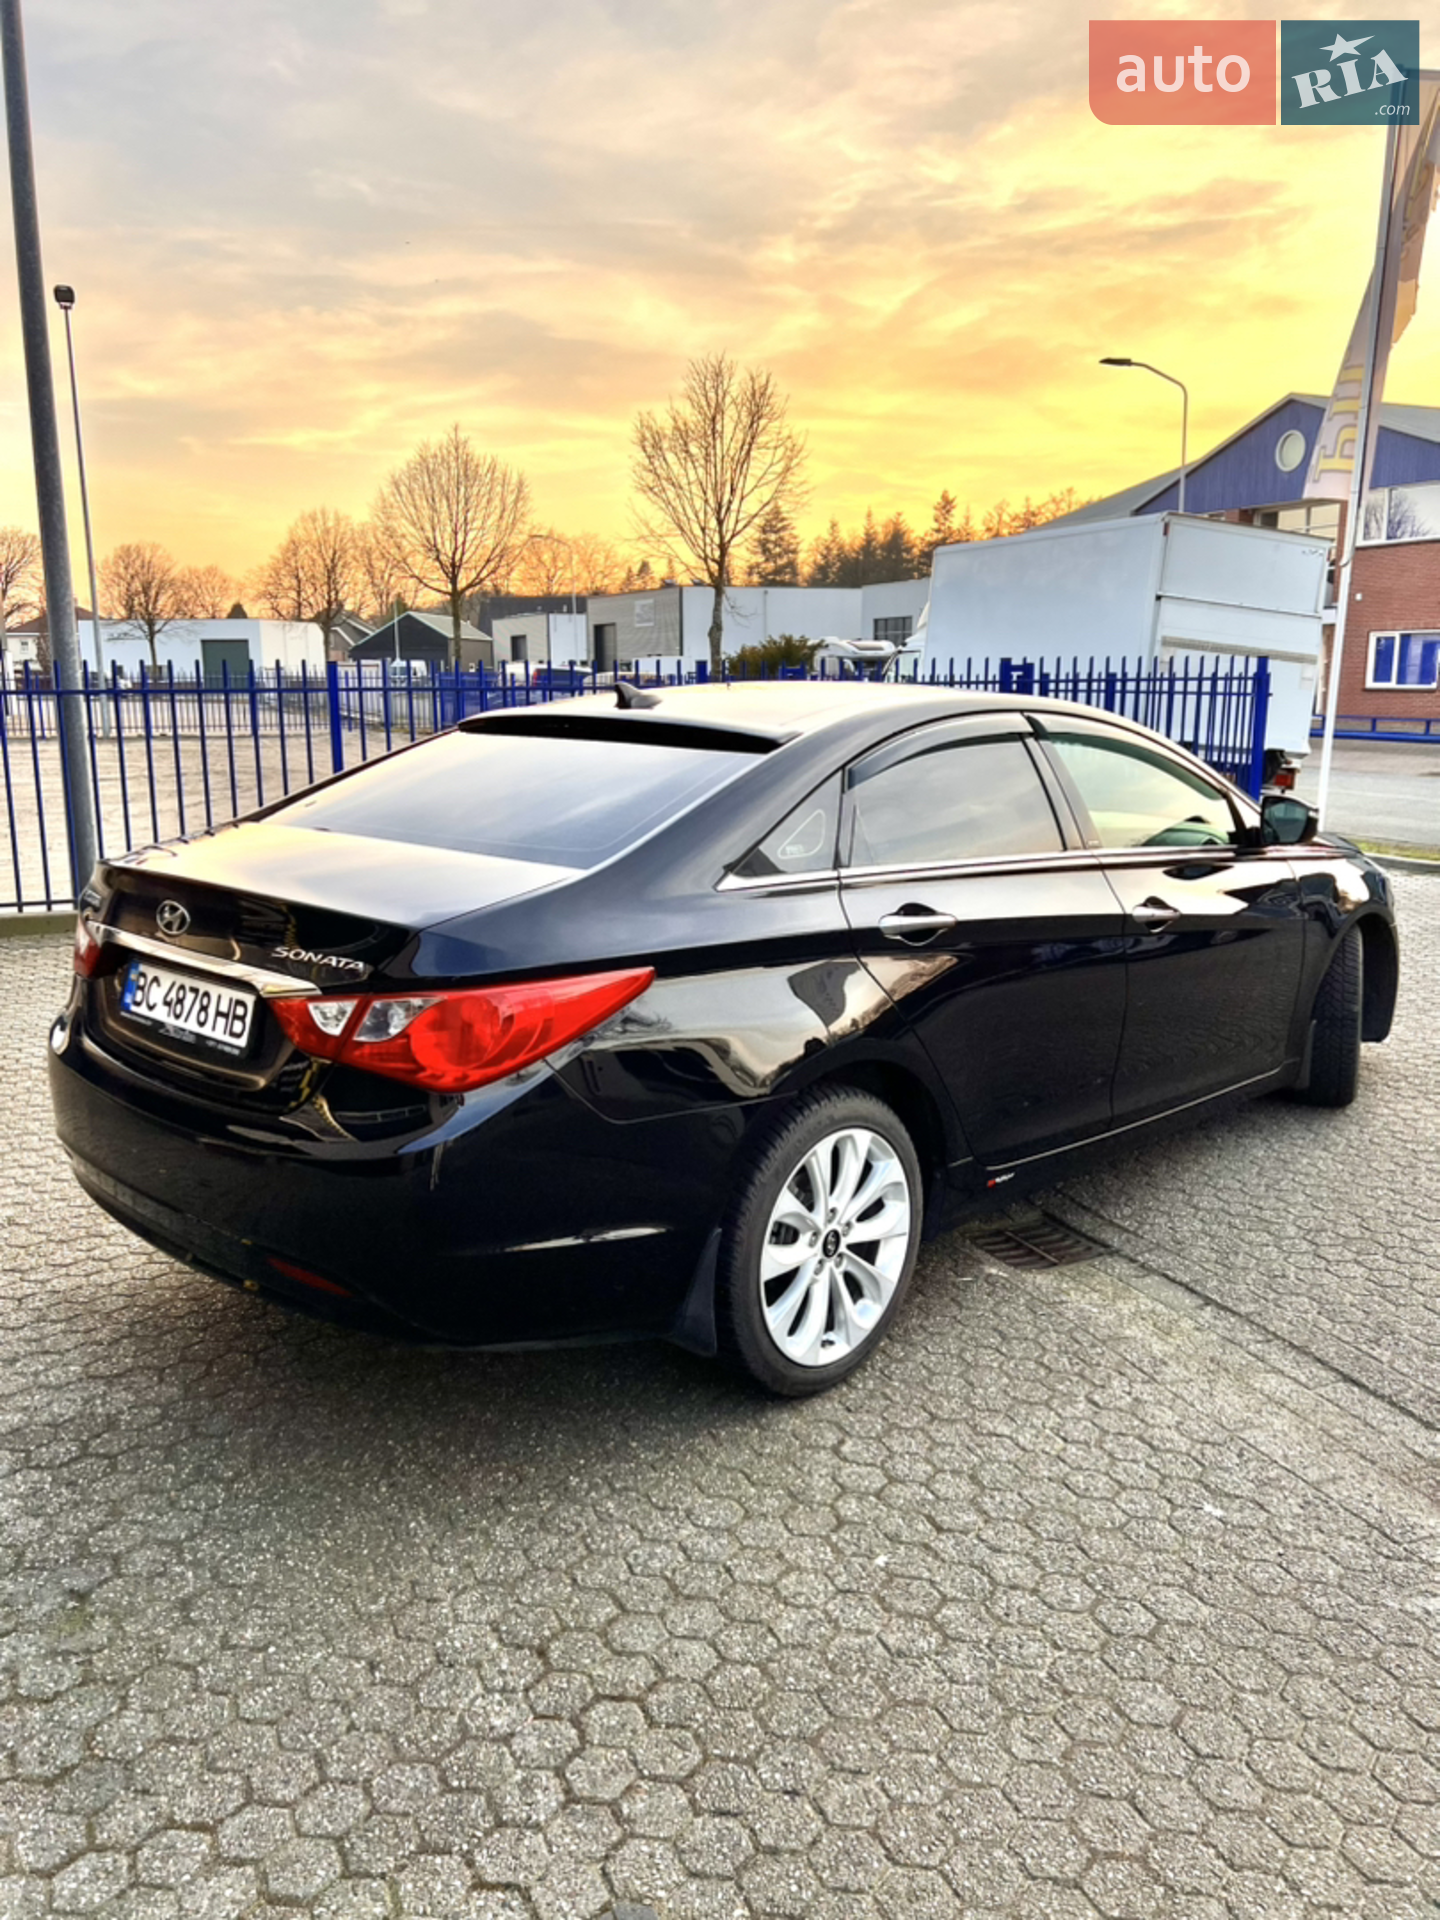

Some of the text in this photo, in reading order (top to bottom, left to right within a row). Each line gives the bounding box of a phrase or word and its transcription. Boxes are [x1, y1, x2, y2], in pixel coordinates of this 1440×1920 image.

[271, 946, 365, 970] SONATA
[132, 971, 158, 1011] BC
[163, 981, 211, 1027] 4878
[212, 994, 248, 1038] HB
